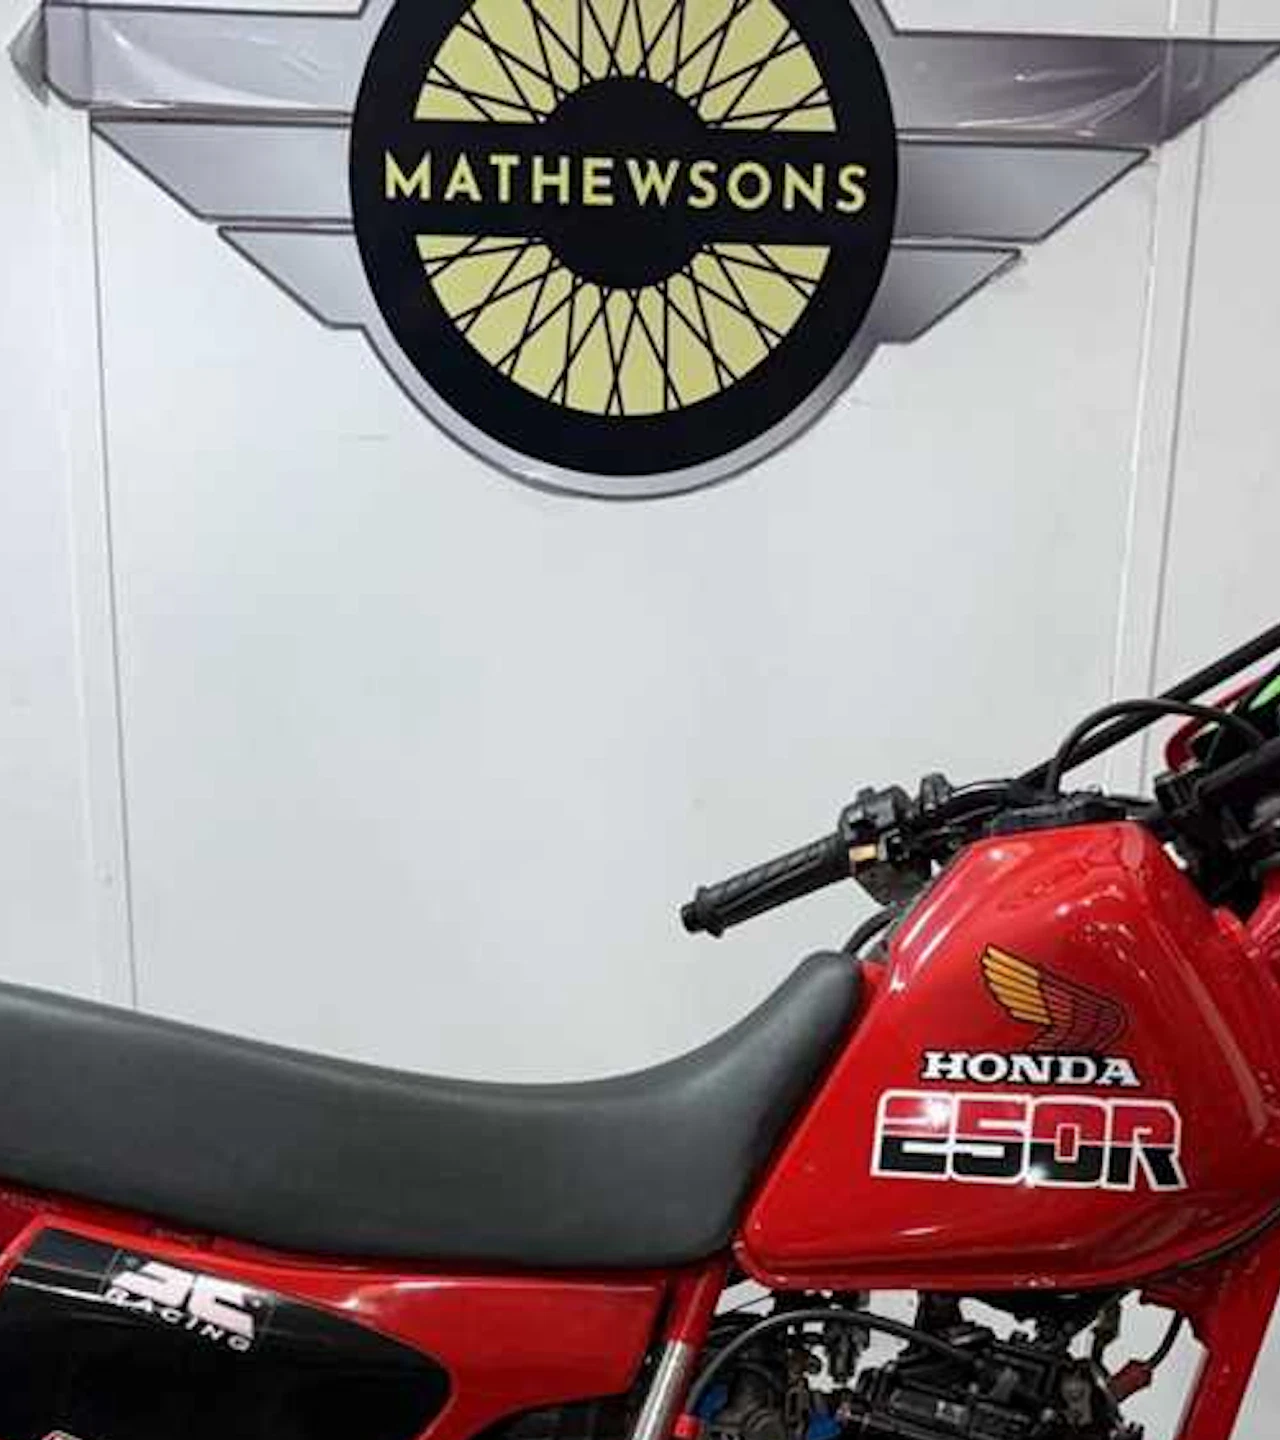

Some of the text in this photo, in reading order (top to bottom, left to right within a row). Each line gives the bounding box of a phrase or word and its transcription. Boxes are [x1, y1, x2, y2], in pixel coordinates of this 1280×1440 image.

[383, 149, 868, 213] MATHEWSONS
[921, 1051, 1141, 1087] HONDA
[105, 1287, 252, 1352] RACING
